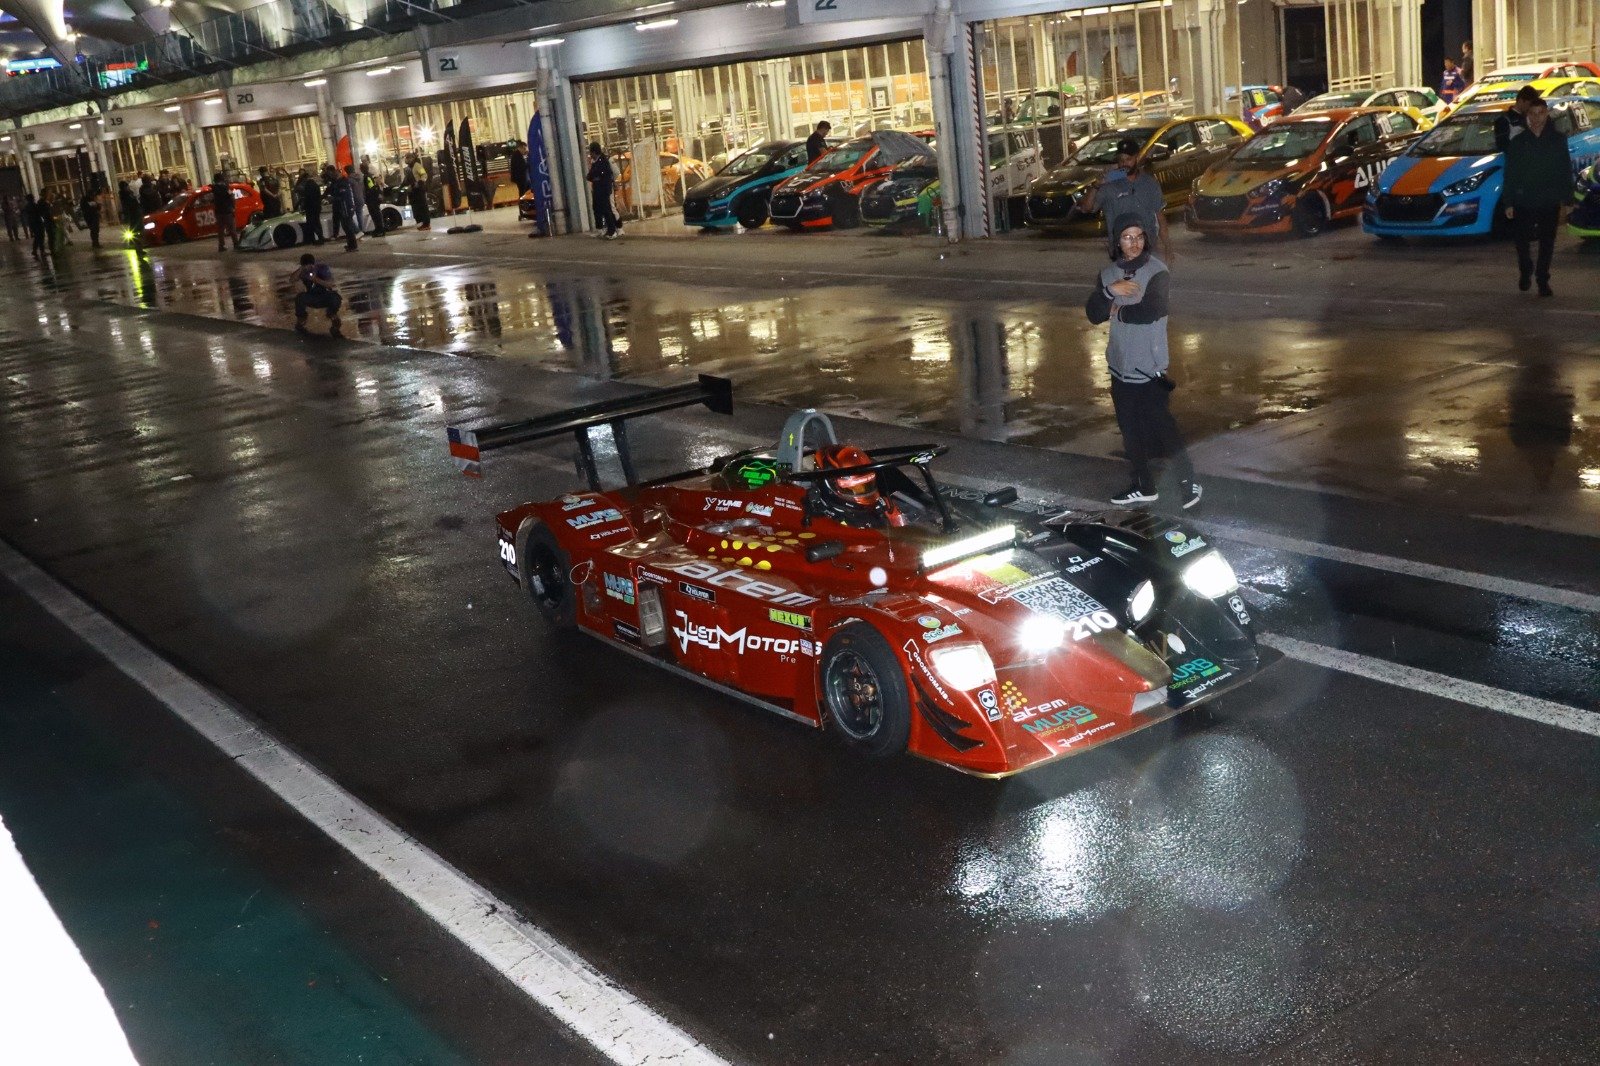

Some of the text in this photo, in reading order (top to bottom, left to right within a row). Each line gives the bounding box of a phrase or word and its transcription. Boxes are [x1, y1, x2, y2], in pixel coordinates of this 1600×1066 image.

[440, 58, 458, 71] 21
[237, 93, 254, 104] 20
[110, 117, 123, 126] 19
[717, 499, 743, 508] YUME
[499, 539, 516, 565] 210
[1065, 611, 1118, 641] 210
[913, 652, 949, 699] ODONTOMAIS
[1172, 657, 1214, 681] URB
[1012, 699, 1068, 723] atem
[1022, 705, 1092, 734] MURB
